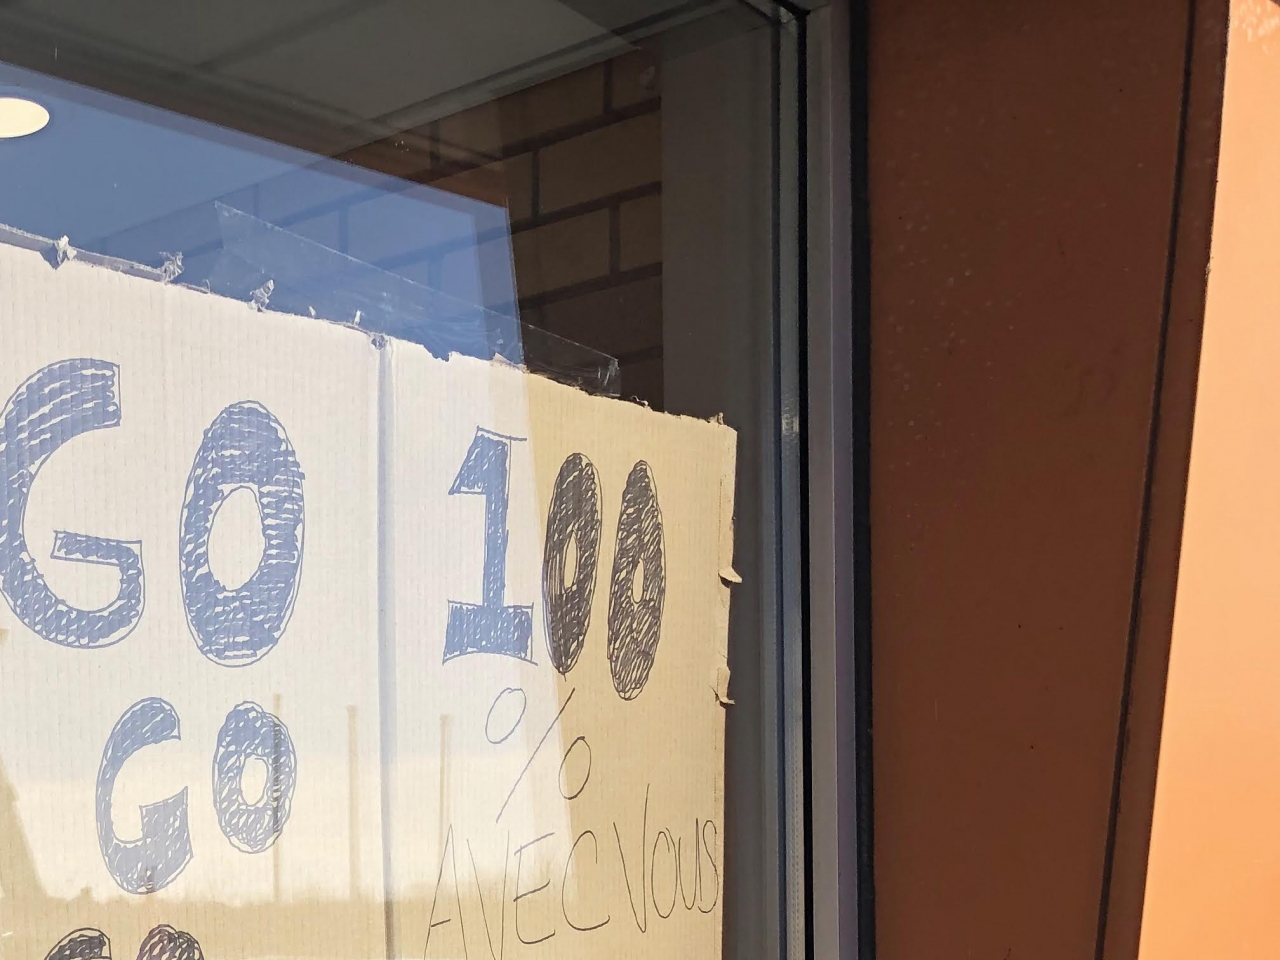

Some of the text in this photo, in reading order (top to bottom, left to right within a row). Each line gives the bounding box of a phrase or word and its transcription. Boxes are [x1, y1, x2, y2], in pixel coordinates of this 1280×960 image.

[442, 426, 667, 701] 100
[95, 696, 298, 896] GO
[485, 687, 592, 824] %
[612, 783, 719, 934] VOUS
